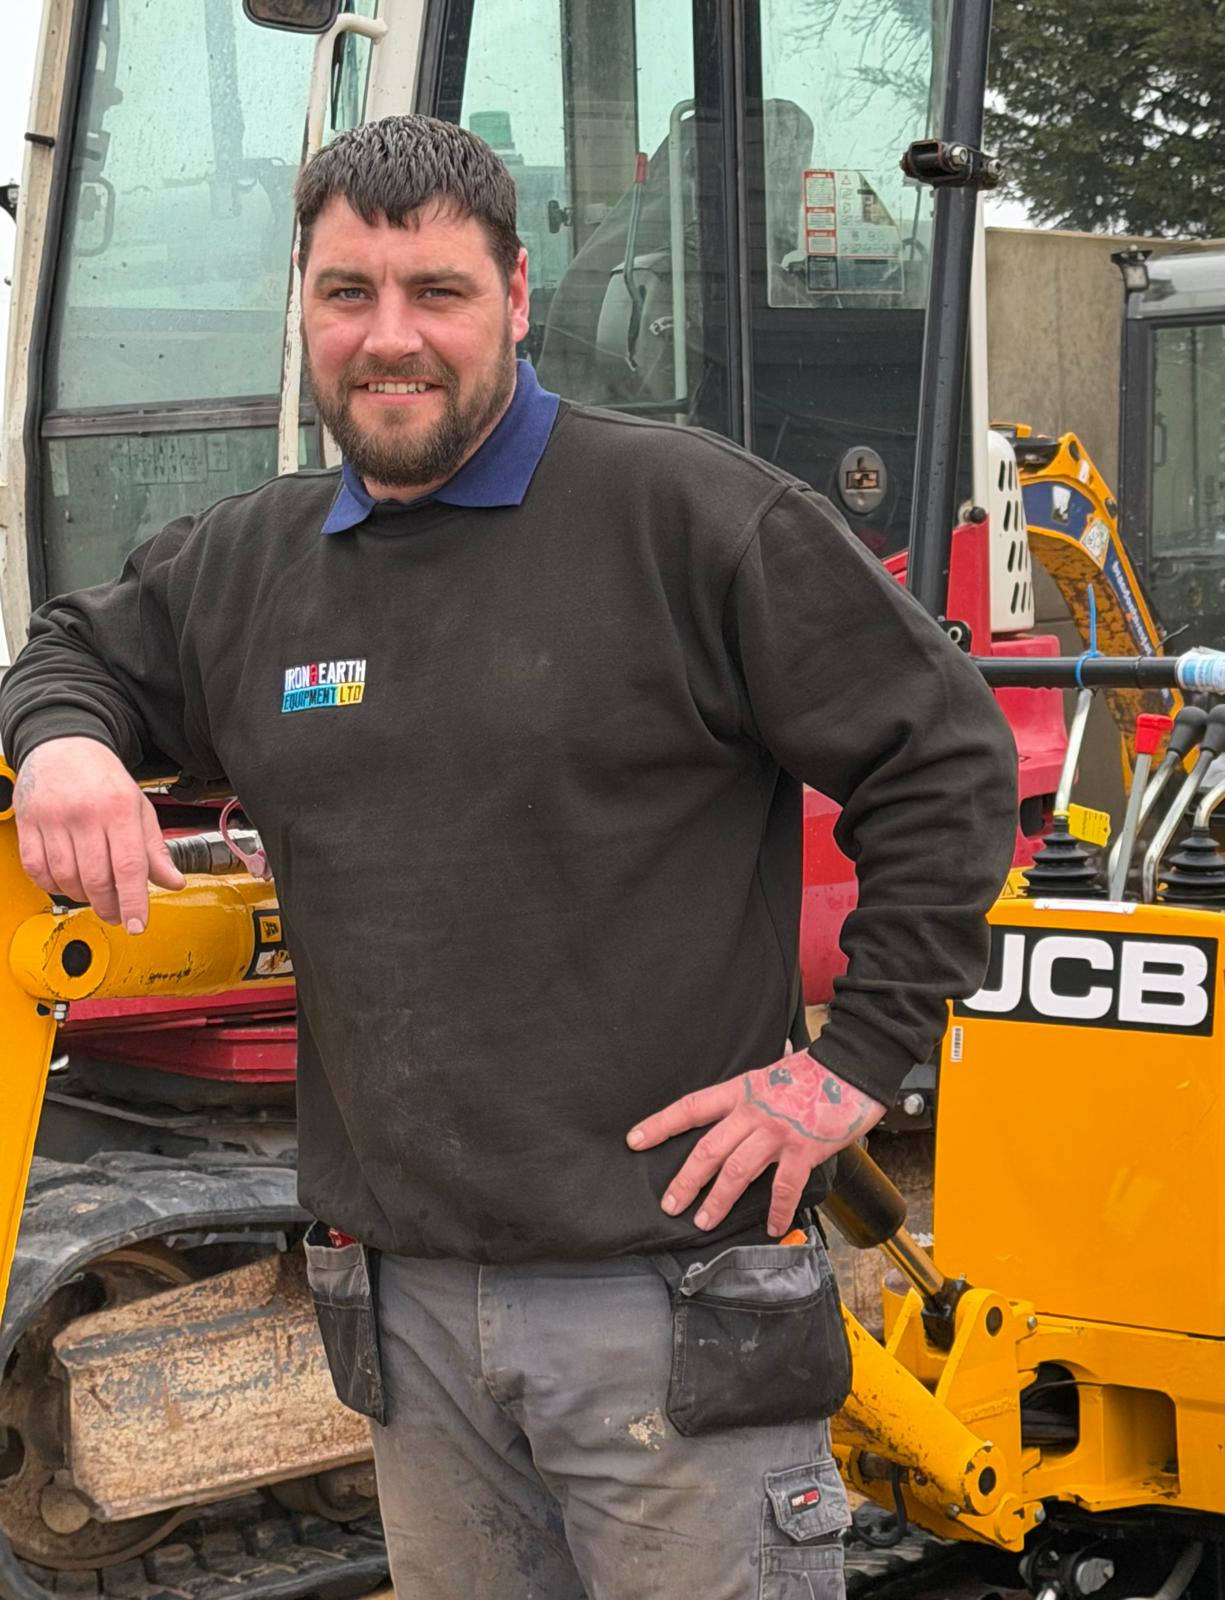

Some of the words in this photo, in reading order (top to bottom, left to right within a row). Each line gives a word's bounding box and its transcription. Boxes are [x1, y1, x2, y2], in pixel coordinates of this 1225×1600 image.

[283, 687, 336, 711] EQUIPMENT
[339, 685, 362, 703] LTD
[963, 933, 1209, 1027] JCB
